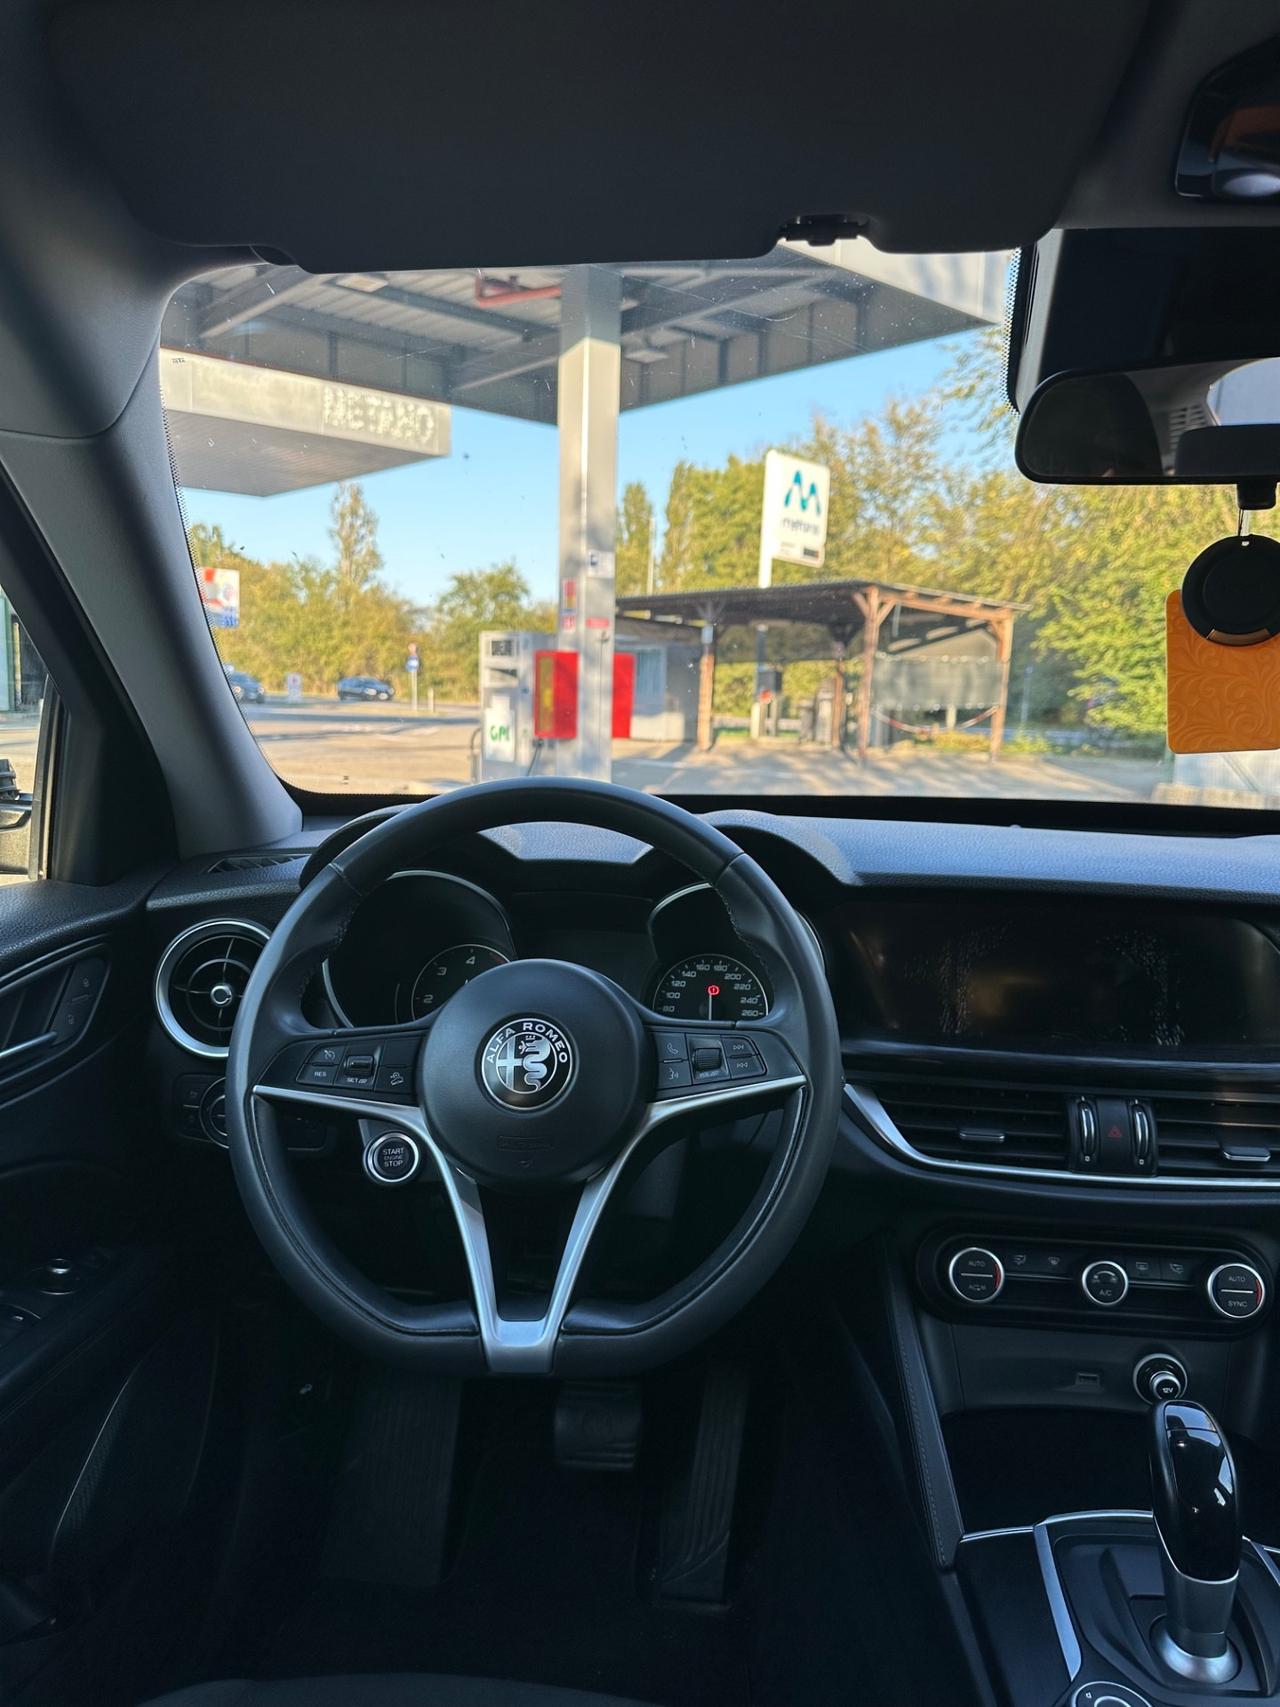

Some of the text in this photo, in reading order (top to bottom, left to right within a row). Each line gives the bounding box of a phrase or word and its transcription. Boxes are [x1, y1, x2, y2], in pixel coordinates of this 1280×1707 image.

[465, 956, 476, 965] 4
[437, 966, 447, 976] 3
[733, 983, 751, 991] 220
[423, 994, 434, 1004] 2
[740, 997, 758, 1005] 240
[486, 1022, 568, 1064] ALFA ROMEO
[383, 1147, 405, 1155] START
[384, 1160, 404, 1168] STOP
[1229, 1275, 1246, 1283] AUTO
[1227, 1300, 1248, 1308] SYNC
